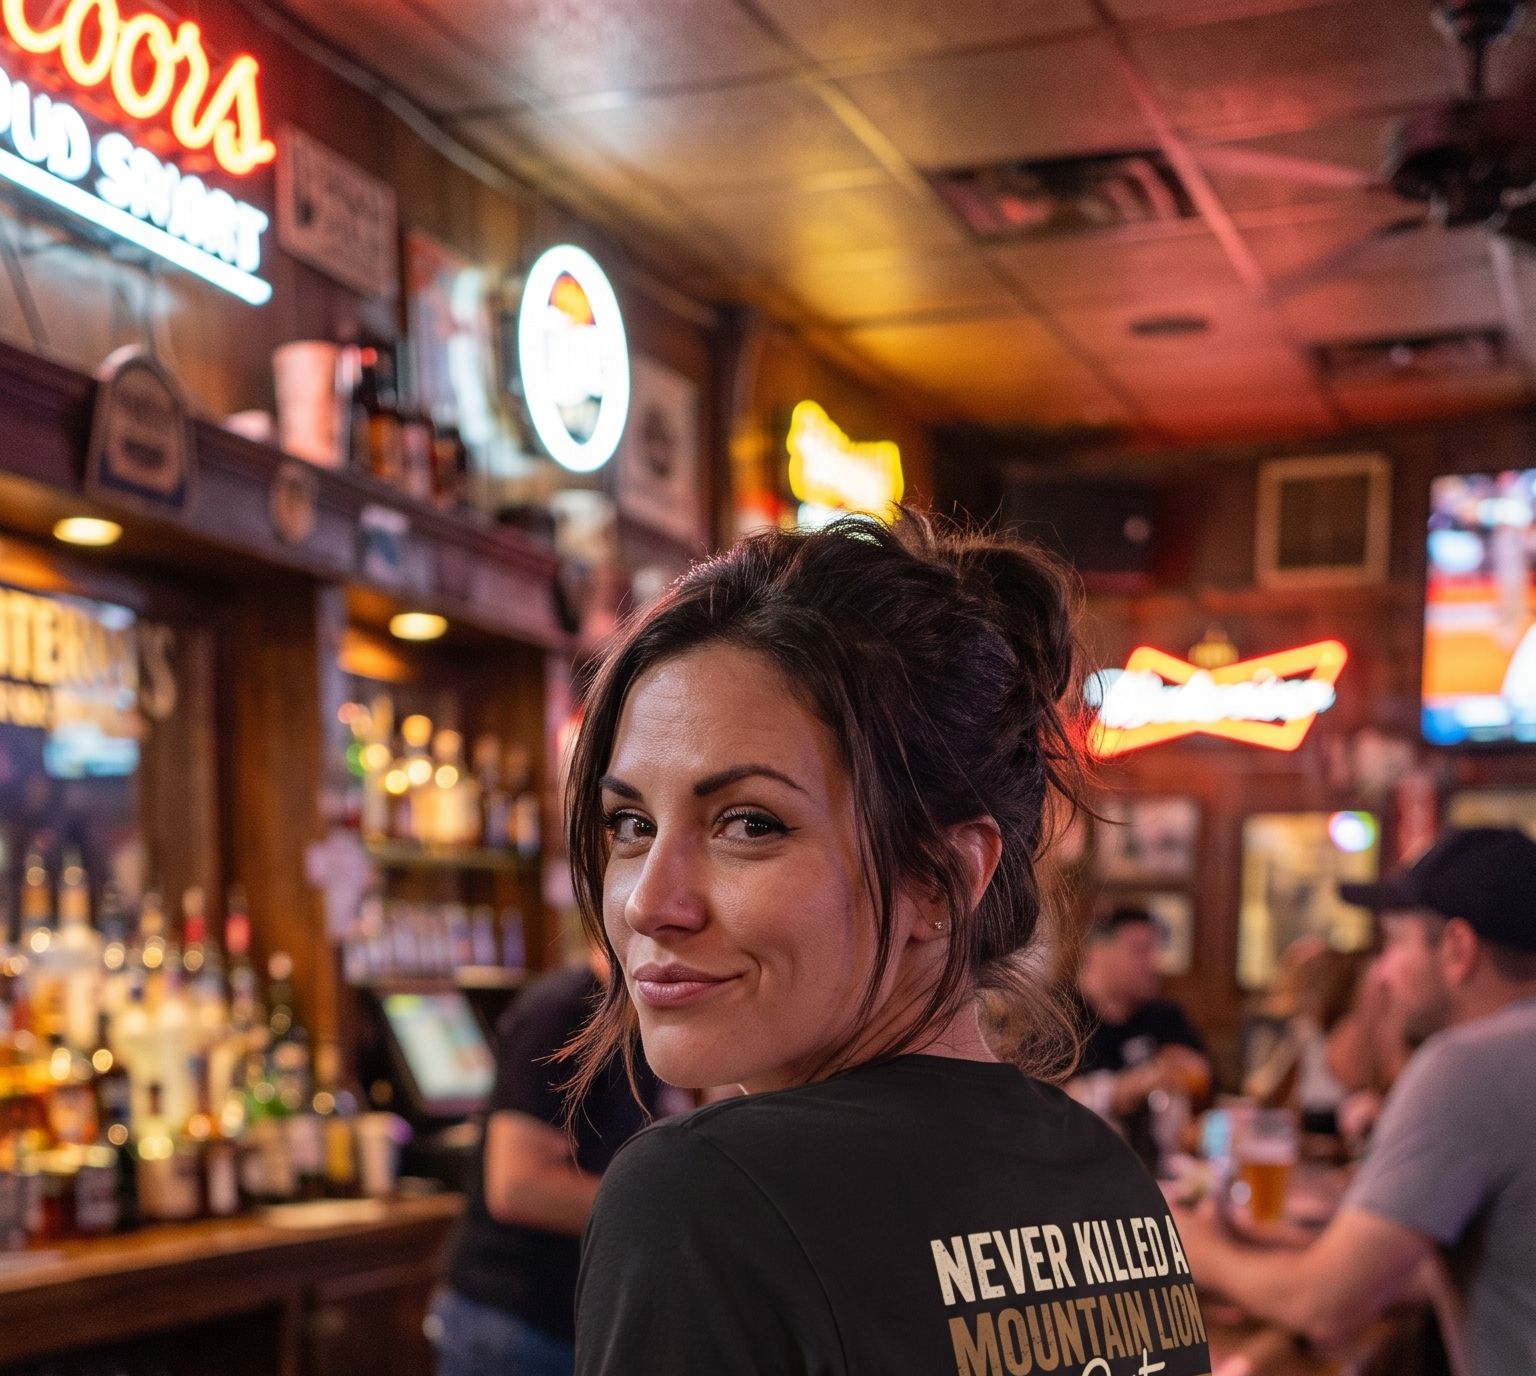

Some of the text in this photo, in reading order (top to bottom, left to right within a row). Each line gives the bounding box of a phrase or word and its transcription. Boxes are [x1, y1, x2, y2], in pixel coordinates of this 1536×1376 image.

[930, 1214, 1190, 1306] NEVER KILLED A
[1149, 1283, 1207, 1351] LION
